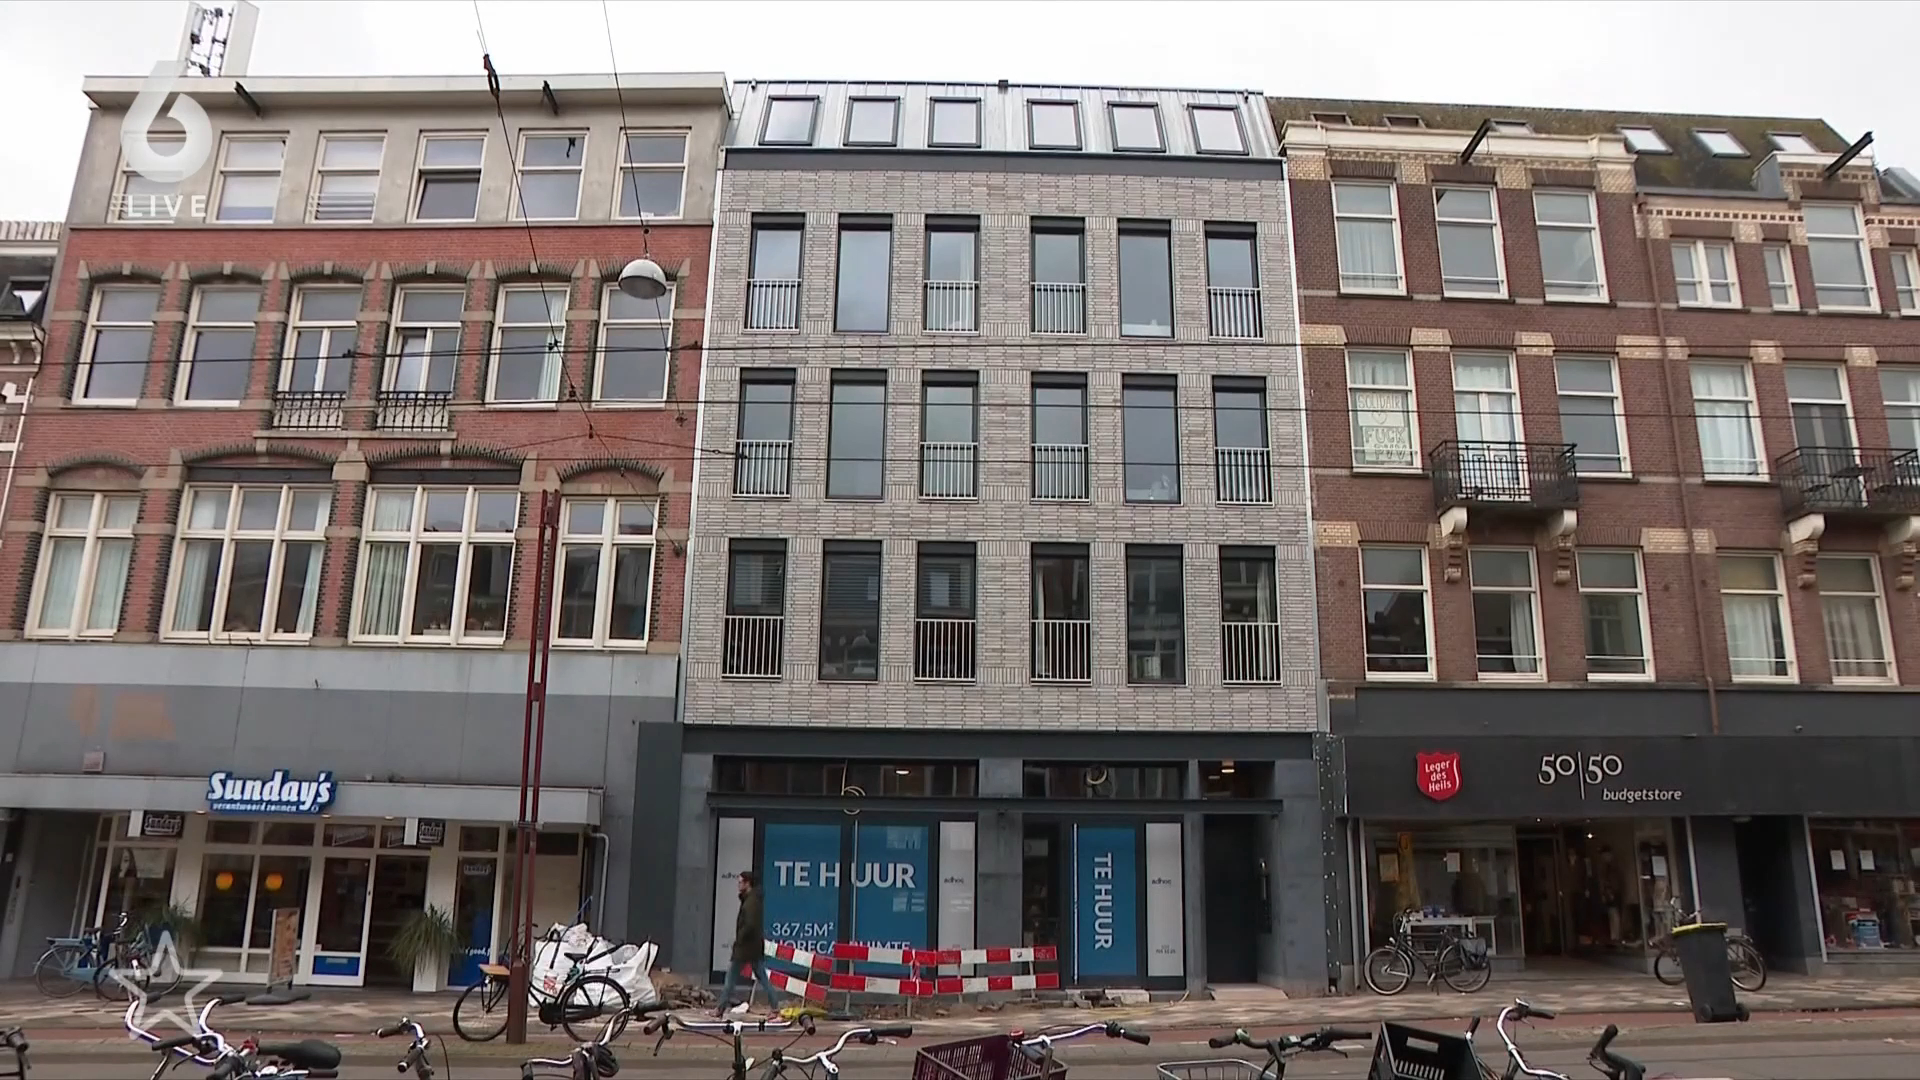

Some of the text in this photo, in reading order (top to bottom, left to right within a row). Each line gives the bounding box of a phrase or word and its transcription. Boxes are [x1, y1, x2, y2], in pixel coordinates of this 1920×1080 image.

[1363, 427, 1406, 444] FUCK
[1425, 760, 1450, 773] Leger
[1430, 771, 1447, 782] des
[207, 770, 332, 811] Sunday's
[1428, 780, 1452, 793] Heils
[1602, 788, 1683, 803] budgetstore
[212, 802, 266, 812] verantwoord
[773, 860, 916, 889] TE HUUR
[1094, 852, 1114, 950] TE HUUR
